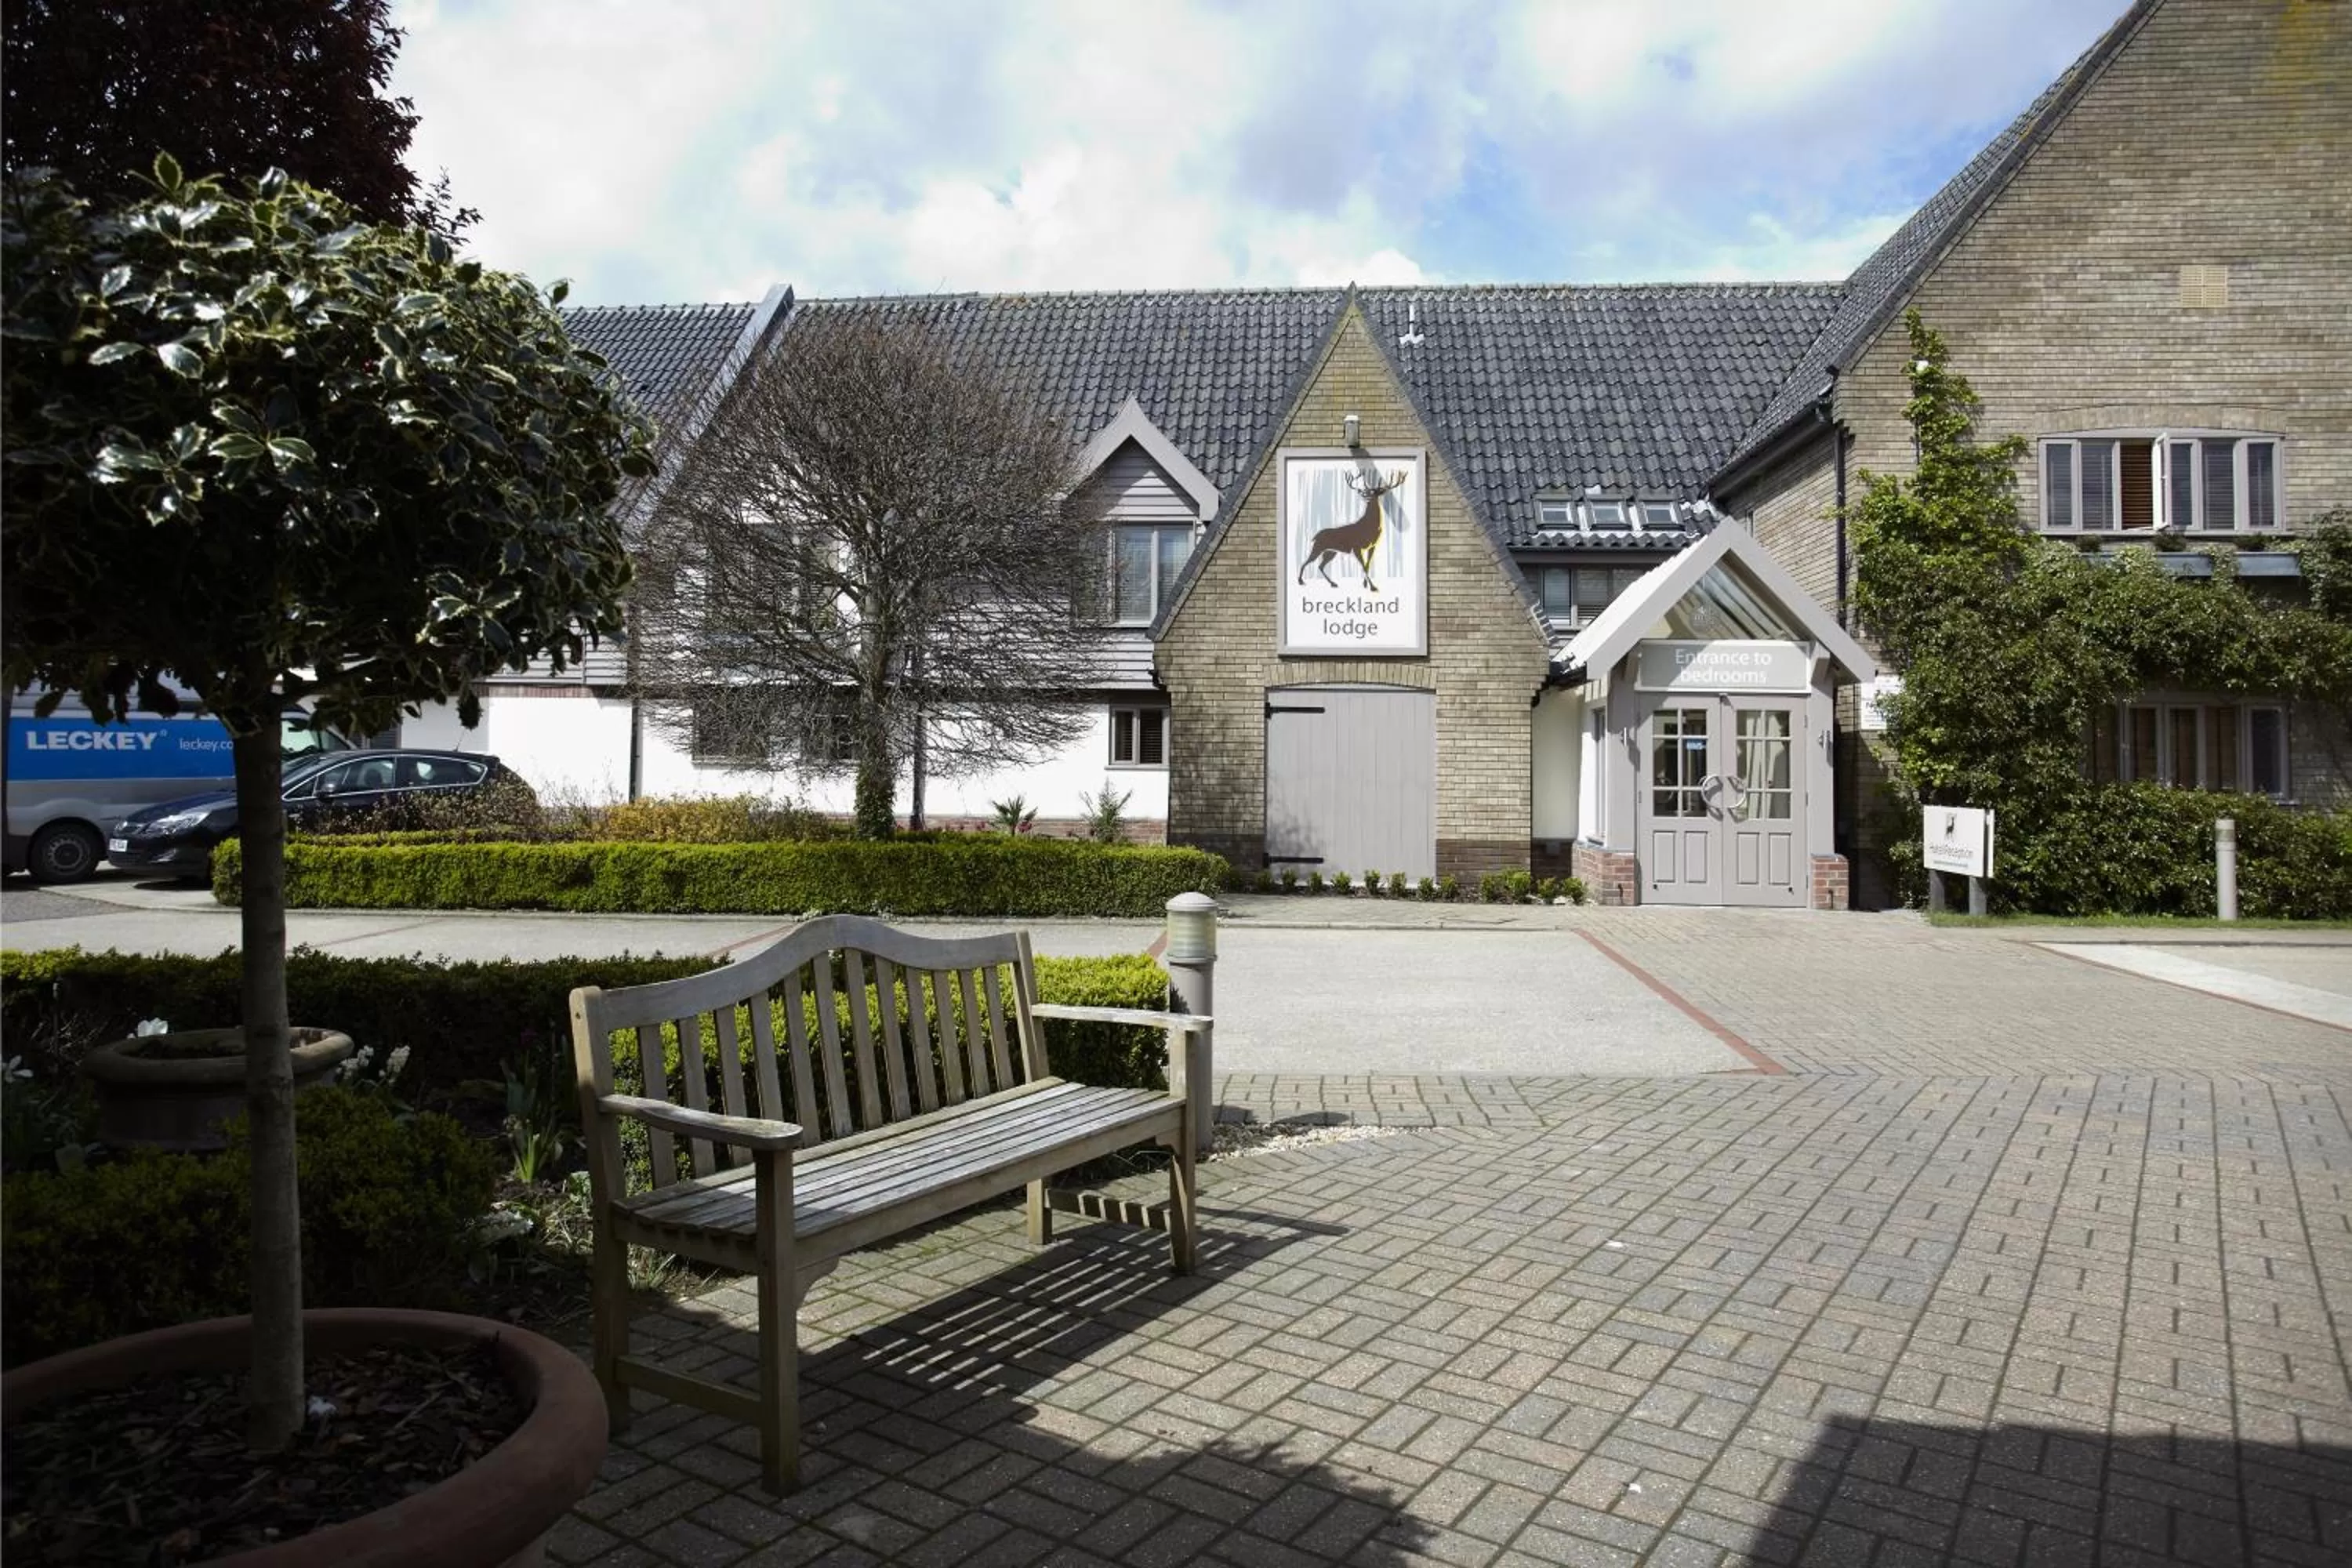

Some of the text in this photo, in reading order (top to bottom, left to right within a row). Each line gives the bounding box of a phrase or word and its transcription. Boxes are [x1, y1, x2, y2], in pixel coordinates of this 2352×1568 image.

[1302, 596, 1399, 613] breckland
[1323, 618, 1377, 639] lodge
[1675, 648, 1772, 666] Entrance to
[1680, 666, 1766, 684] bedrooms
[26, 731, 234, 753] LECKEY leckey.co
